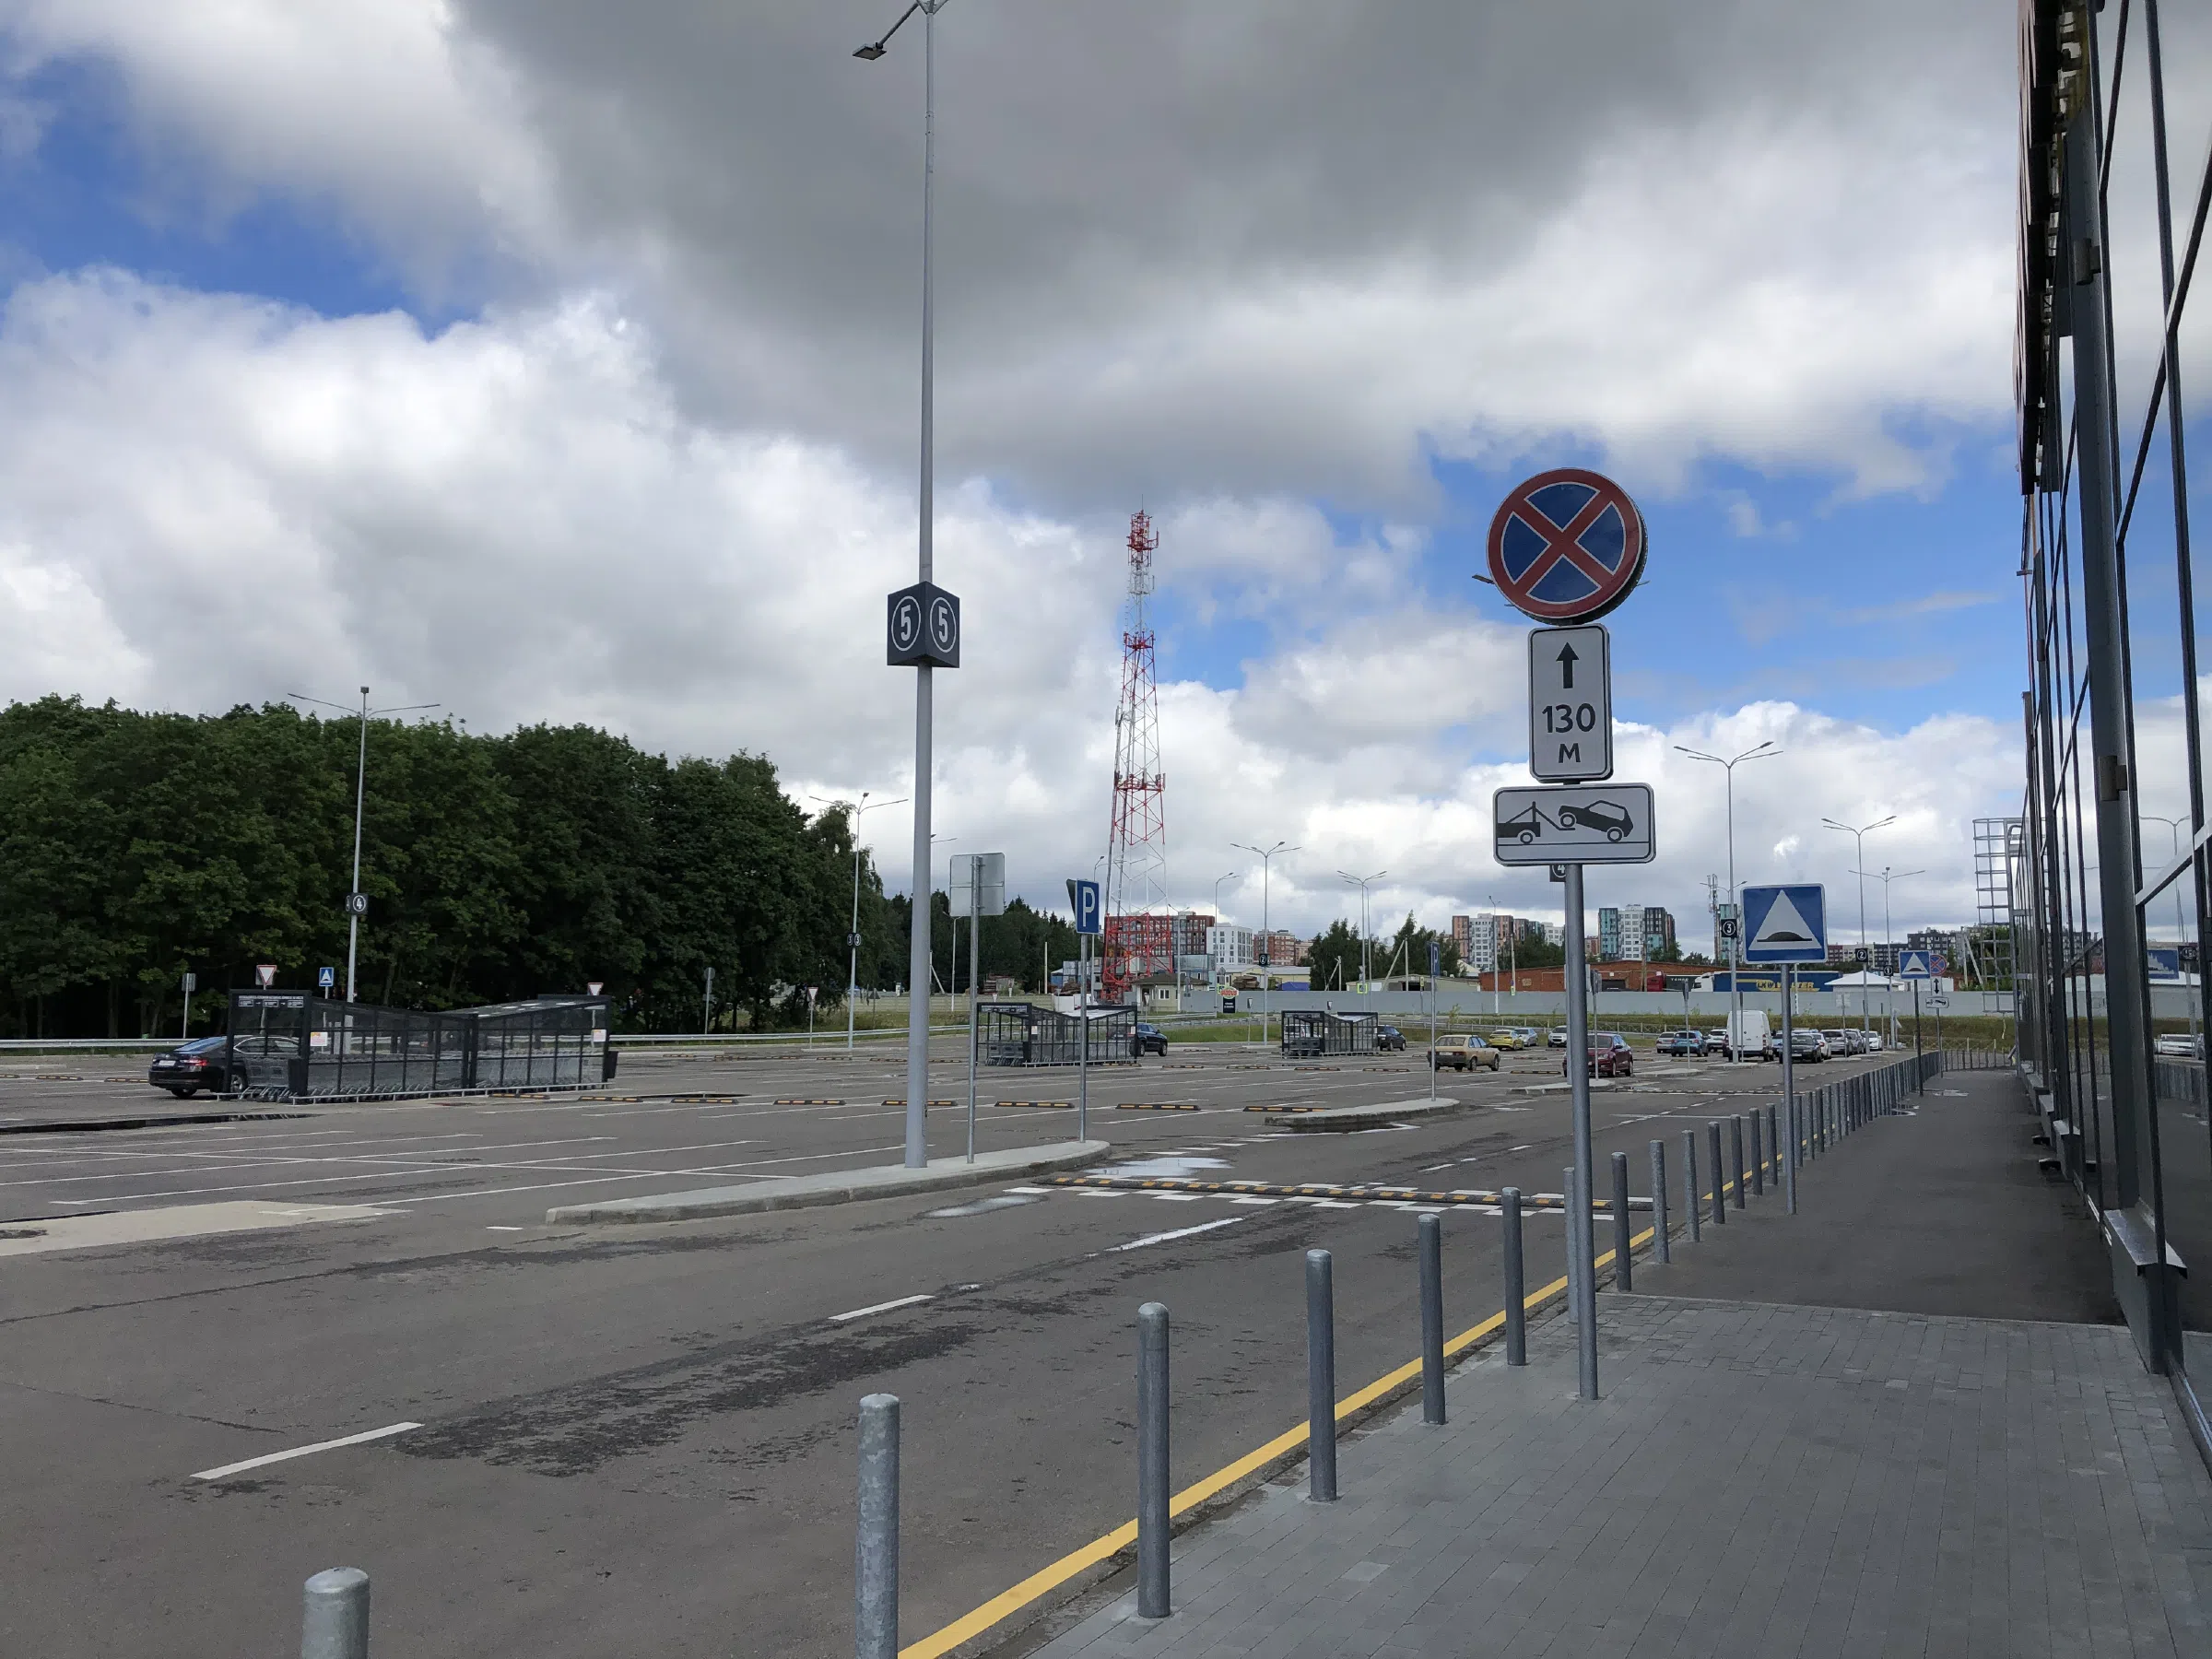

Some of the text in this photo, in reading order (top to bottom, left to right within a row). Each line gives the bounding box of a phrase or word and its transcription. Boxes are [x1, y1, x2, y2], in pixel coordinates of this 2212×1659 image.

[900, 604, 912, 641] 5
[938, 605, 948, 643] 5
[1542, 702, 1596, 734] 130
[356, 898, 363, 910] 4
[1082, 886, 1096, 927] P
[1726, 923, 1732, 934] 3
[1433, 946, 1439, 972] P
